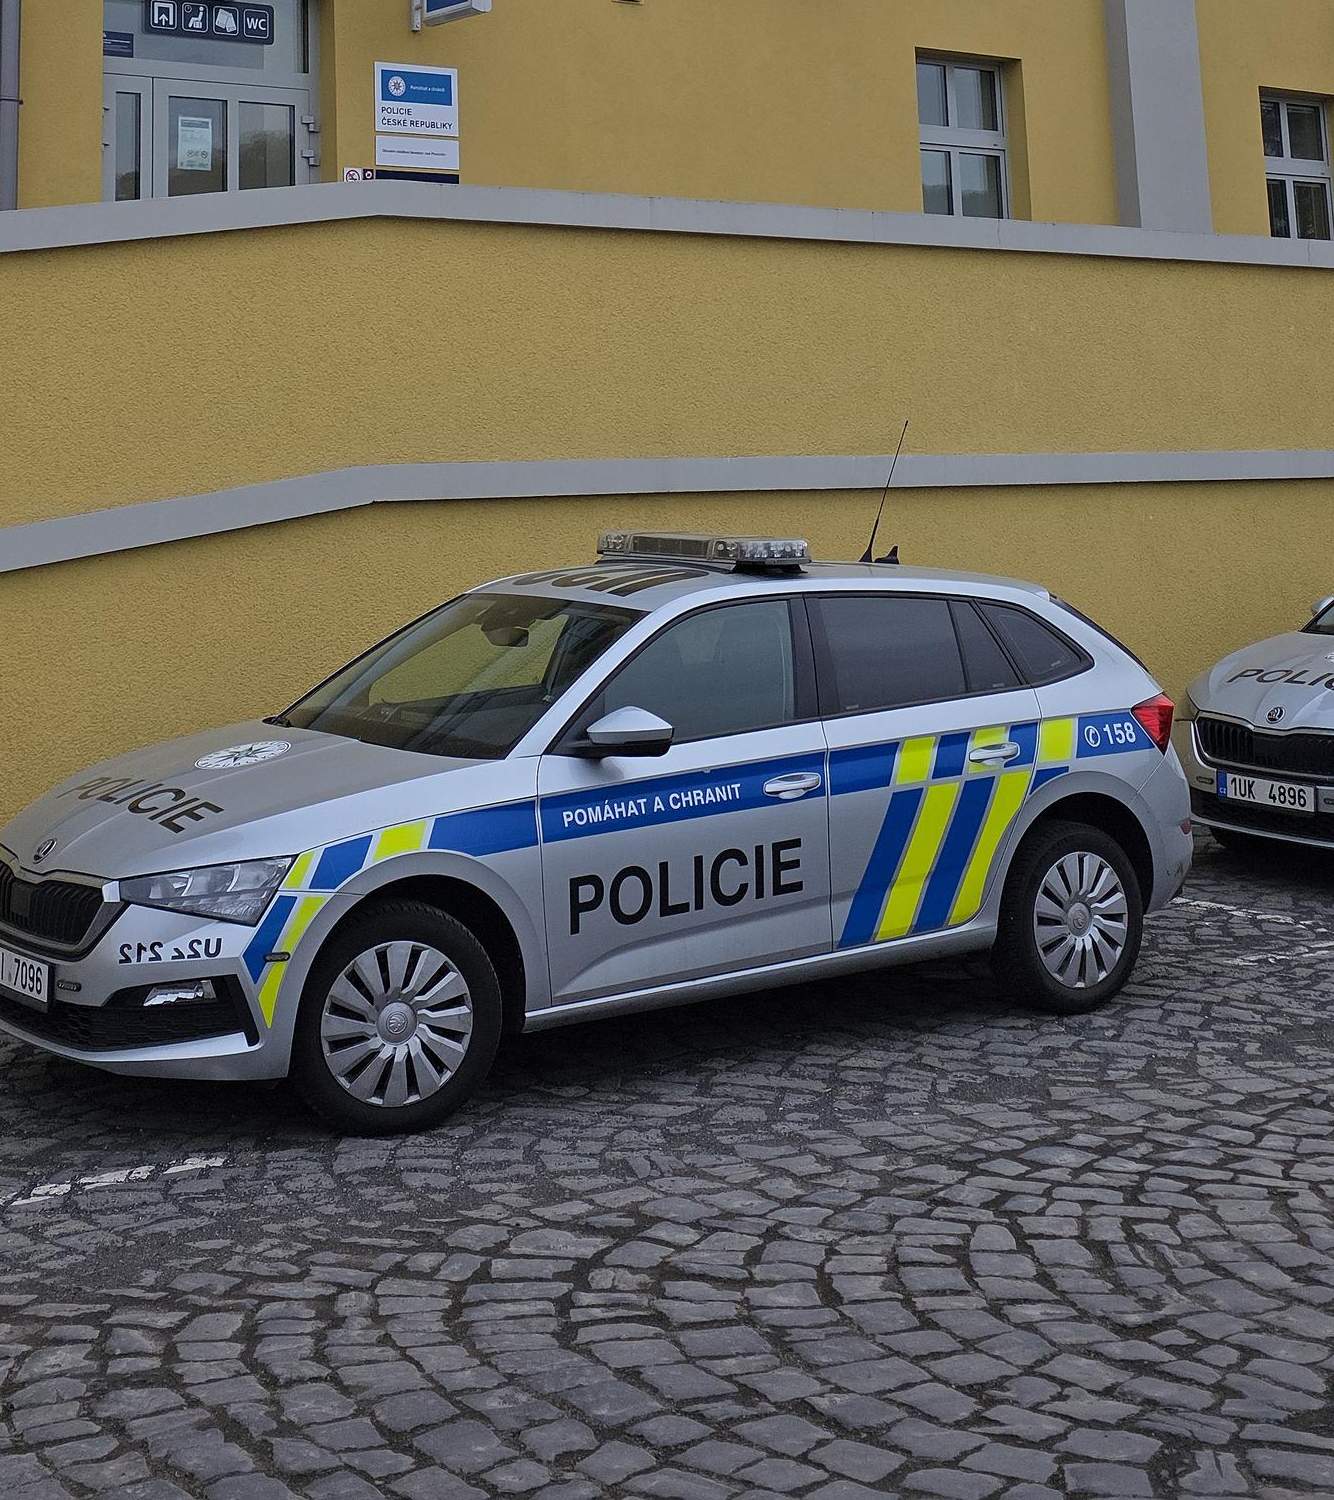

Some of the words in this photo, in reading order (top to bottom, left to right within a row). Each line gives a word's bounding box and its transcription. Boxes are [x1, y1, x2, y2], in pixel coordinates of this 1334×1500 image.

[246, 17, 267, 31] WC
[381, 106, 413, 116] POLICIE
[381, 116, 408, 127] ČESKÉ
[409, 119, 453, 130] REPUBLIKY
[1103, 721, 1136, 745] 158
[56, 777, 225, 834] POLICIE
[562, 799, 647, 828] POMÁHAT
[653, 796, 666, 813] A
[669, 783, 742, 810] CHRANIT
[1230, 777, 1256, 800] 1UK
[1268, 783, 1307, 808] 4896
[569, 837, 804, 936] POLICIE
[13, 957, 43, 995] 7096
